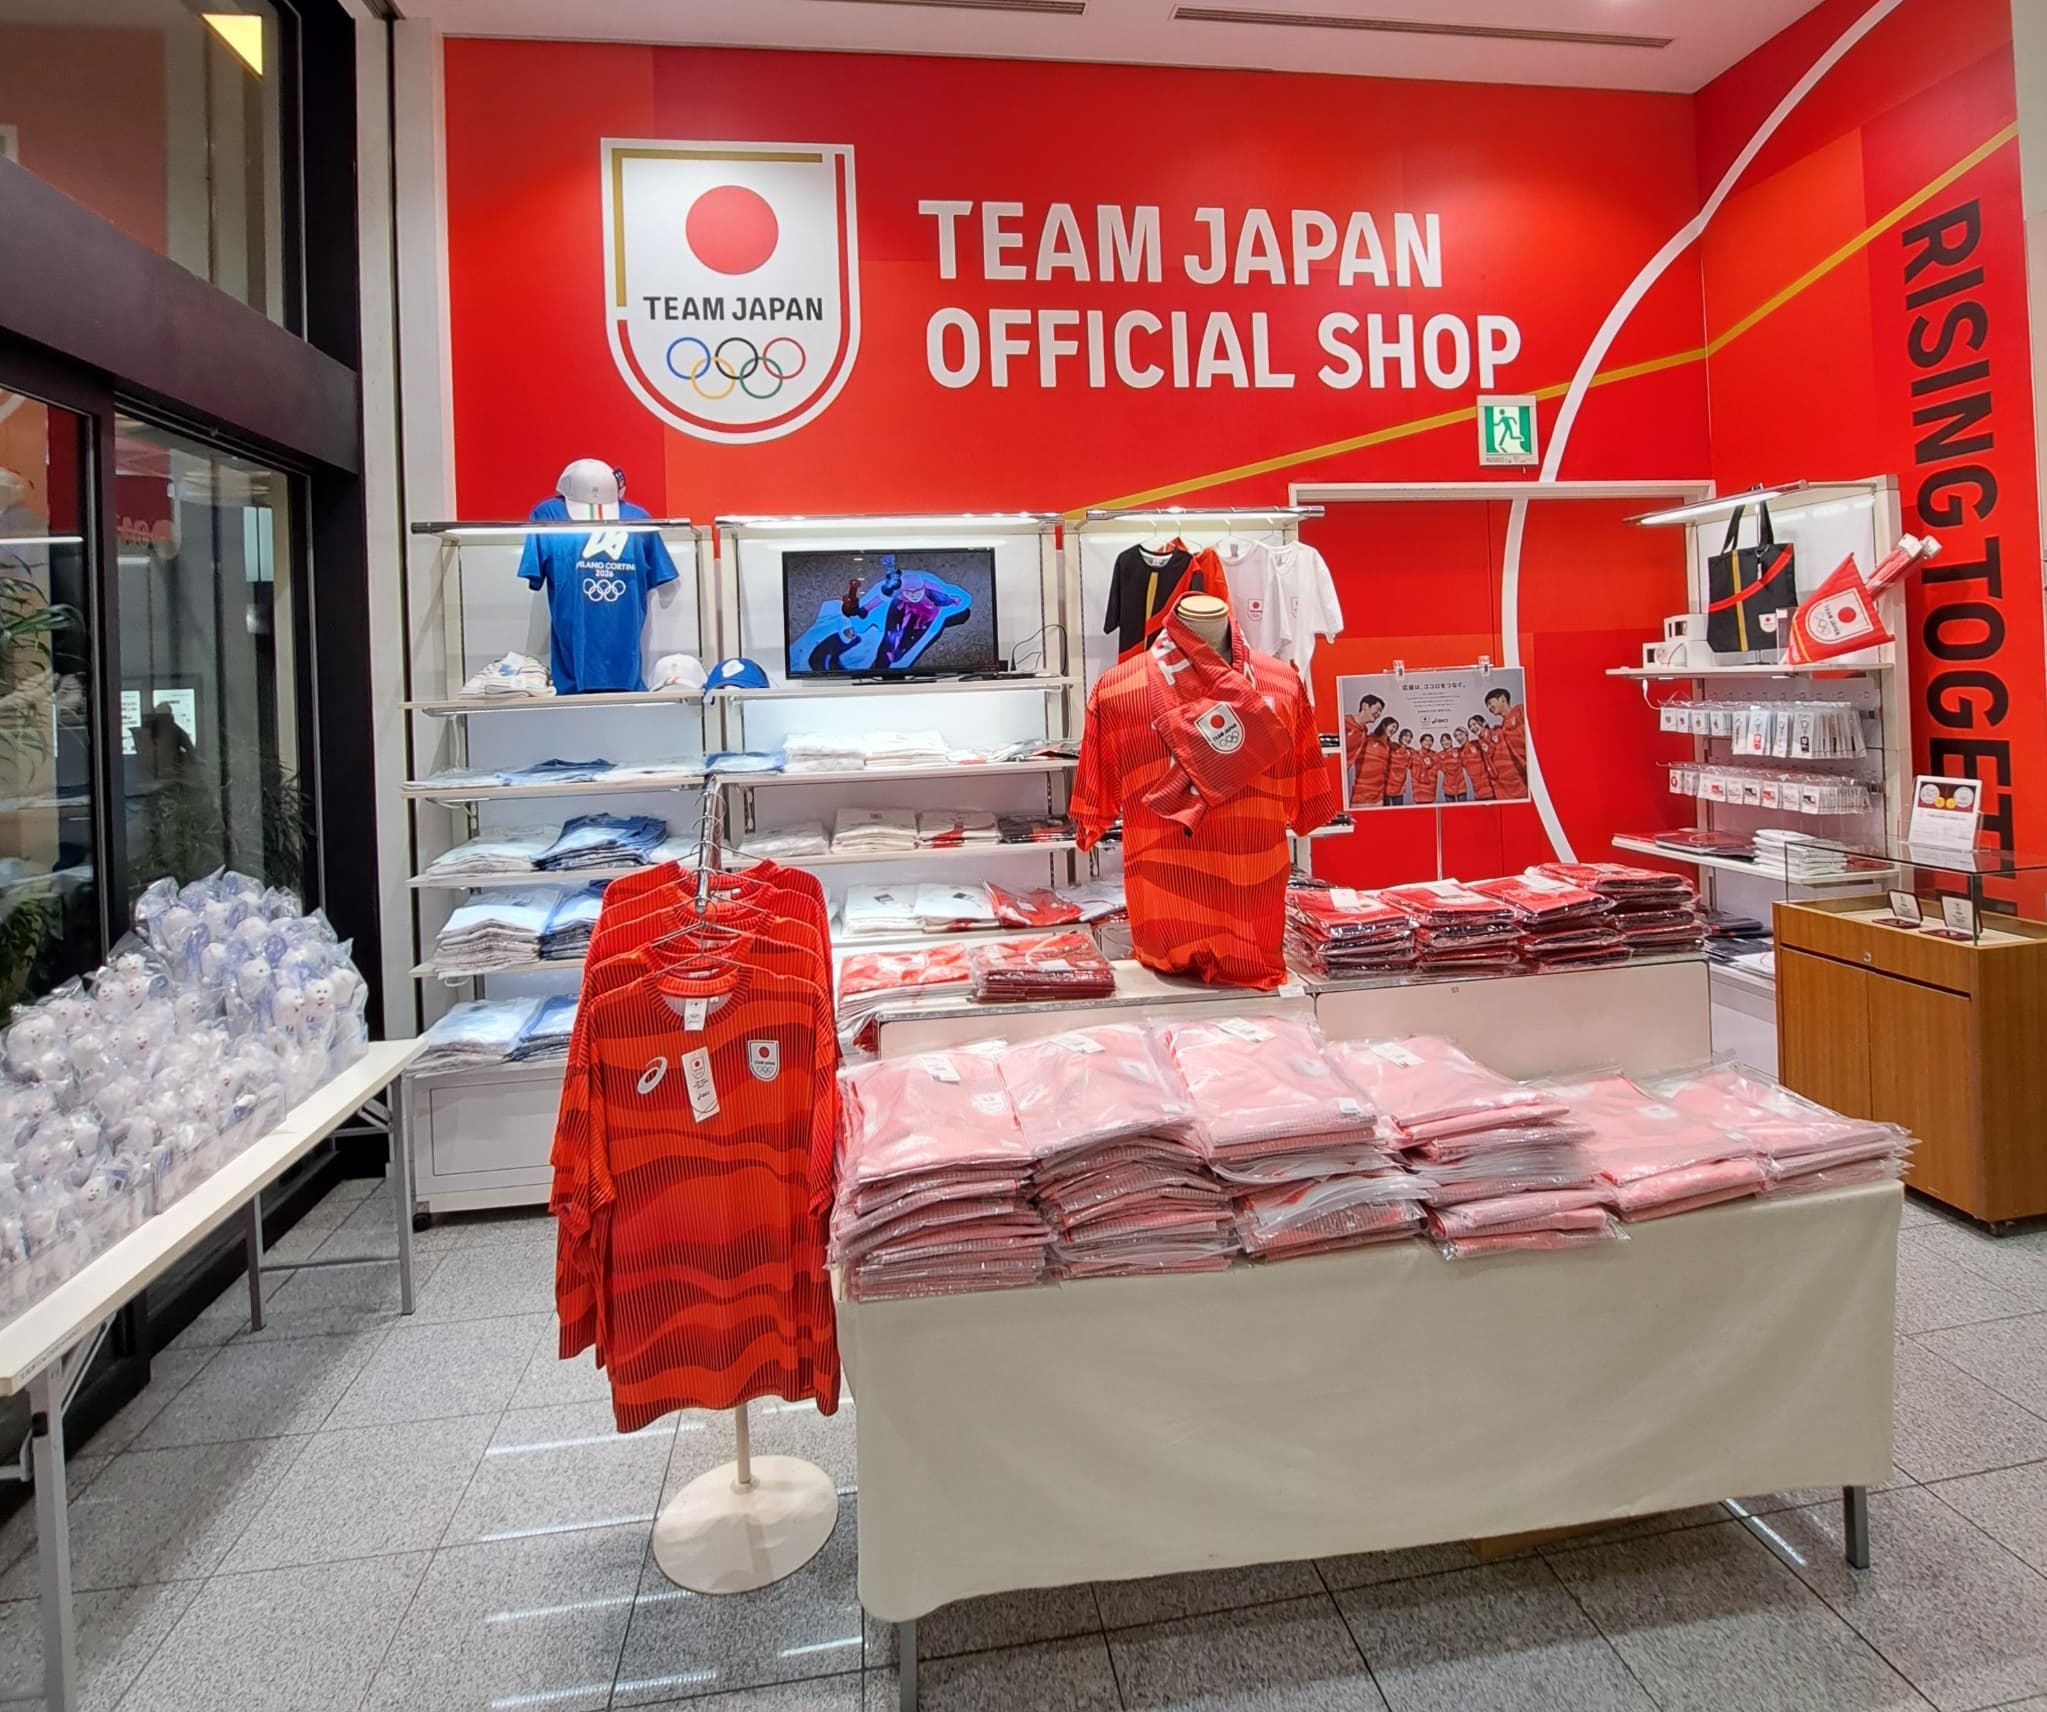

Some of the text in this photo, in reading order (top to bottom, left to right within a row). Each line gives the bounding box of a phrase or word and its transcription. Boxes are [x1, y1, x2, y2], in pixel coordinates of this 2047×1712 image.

[919, 200, 1442, 288] TEAM JAPAN
[643, 296, 822, 321] TEAM JAPAN
[927, 308, 1521, 390] OFFICIAL SHOP
[1902, 198, 1998, 528] RISING
